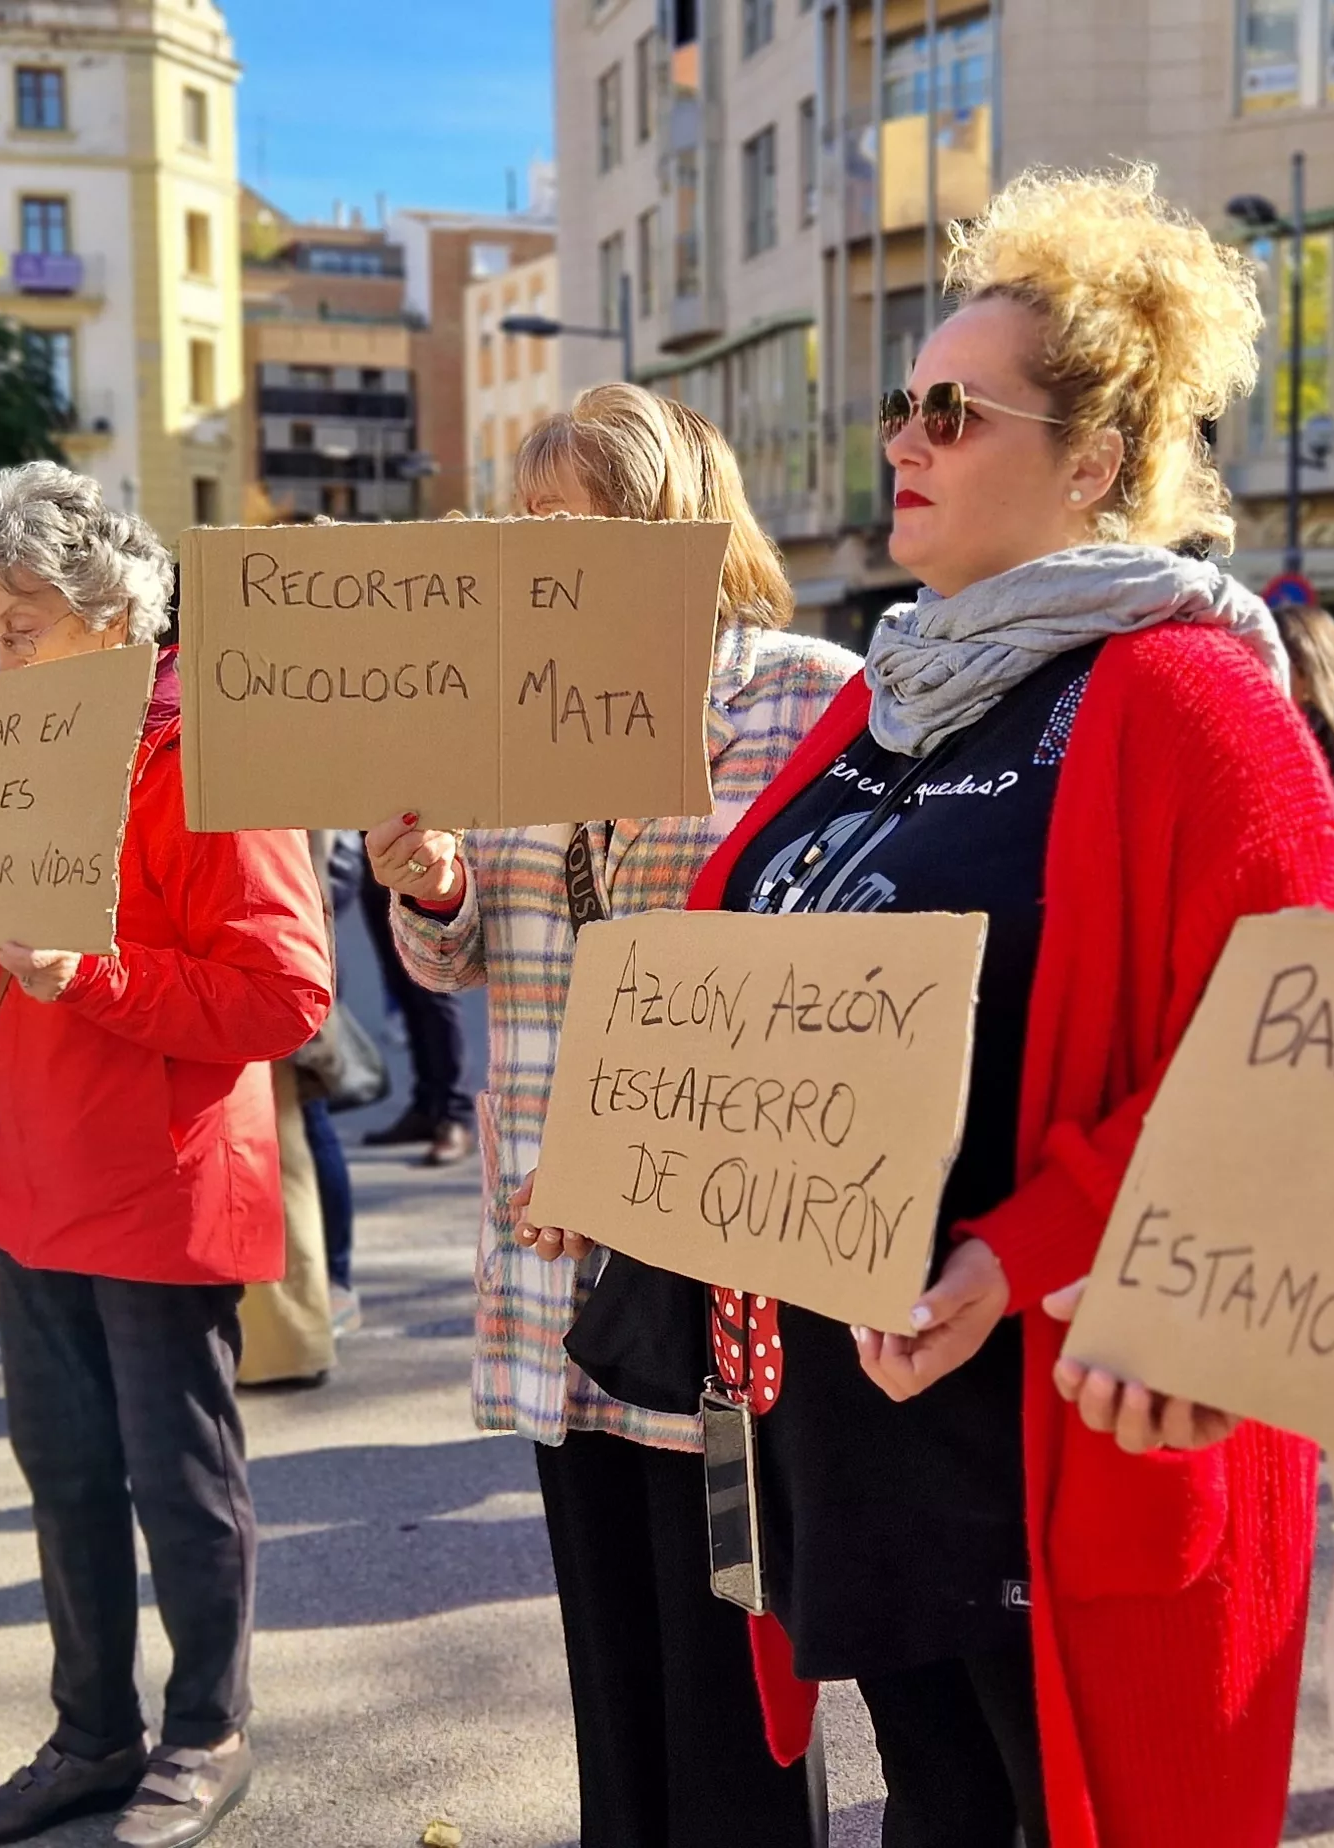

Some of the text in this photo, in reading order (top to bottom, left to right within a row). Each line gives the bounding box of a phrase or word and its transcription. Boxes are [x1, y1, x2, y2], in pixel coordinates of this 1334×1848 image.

[242, 552, 584, 611] RECORTAR EN
[39, 701, 82, 742] EN
[216, 648, 656, 744] ONCOLOGÍA MATA
[0, 778, 35, 810] ES
[605, 939, 752, 1049] AZCÓN,
[621, 1142, 915, 1274] DE QUIRÓN
